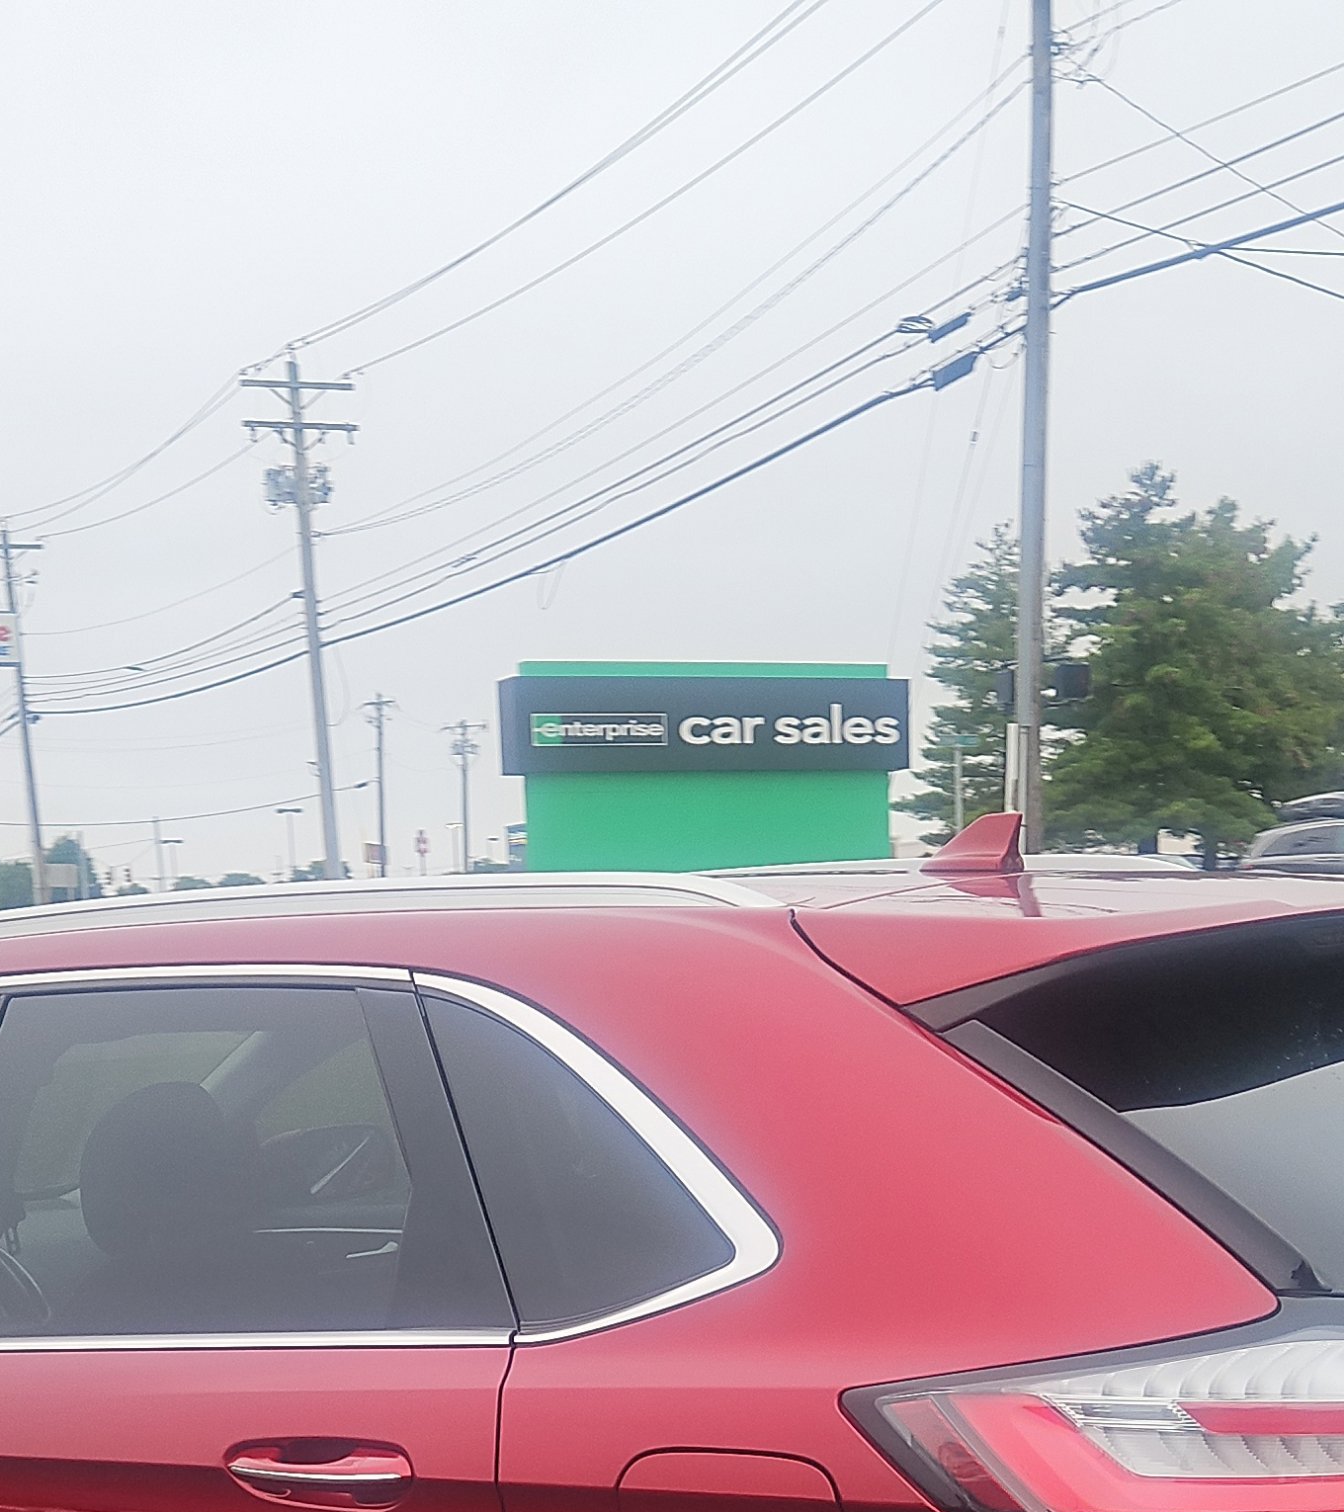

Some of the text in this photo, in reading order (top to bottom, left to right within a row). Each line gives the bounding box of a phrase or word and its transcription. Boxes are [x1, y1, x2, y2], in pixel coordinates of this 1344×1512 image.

[541, 703, 901, 745] enterprise car sales
